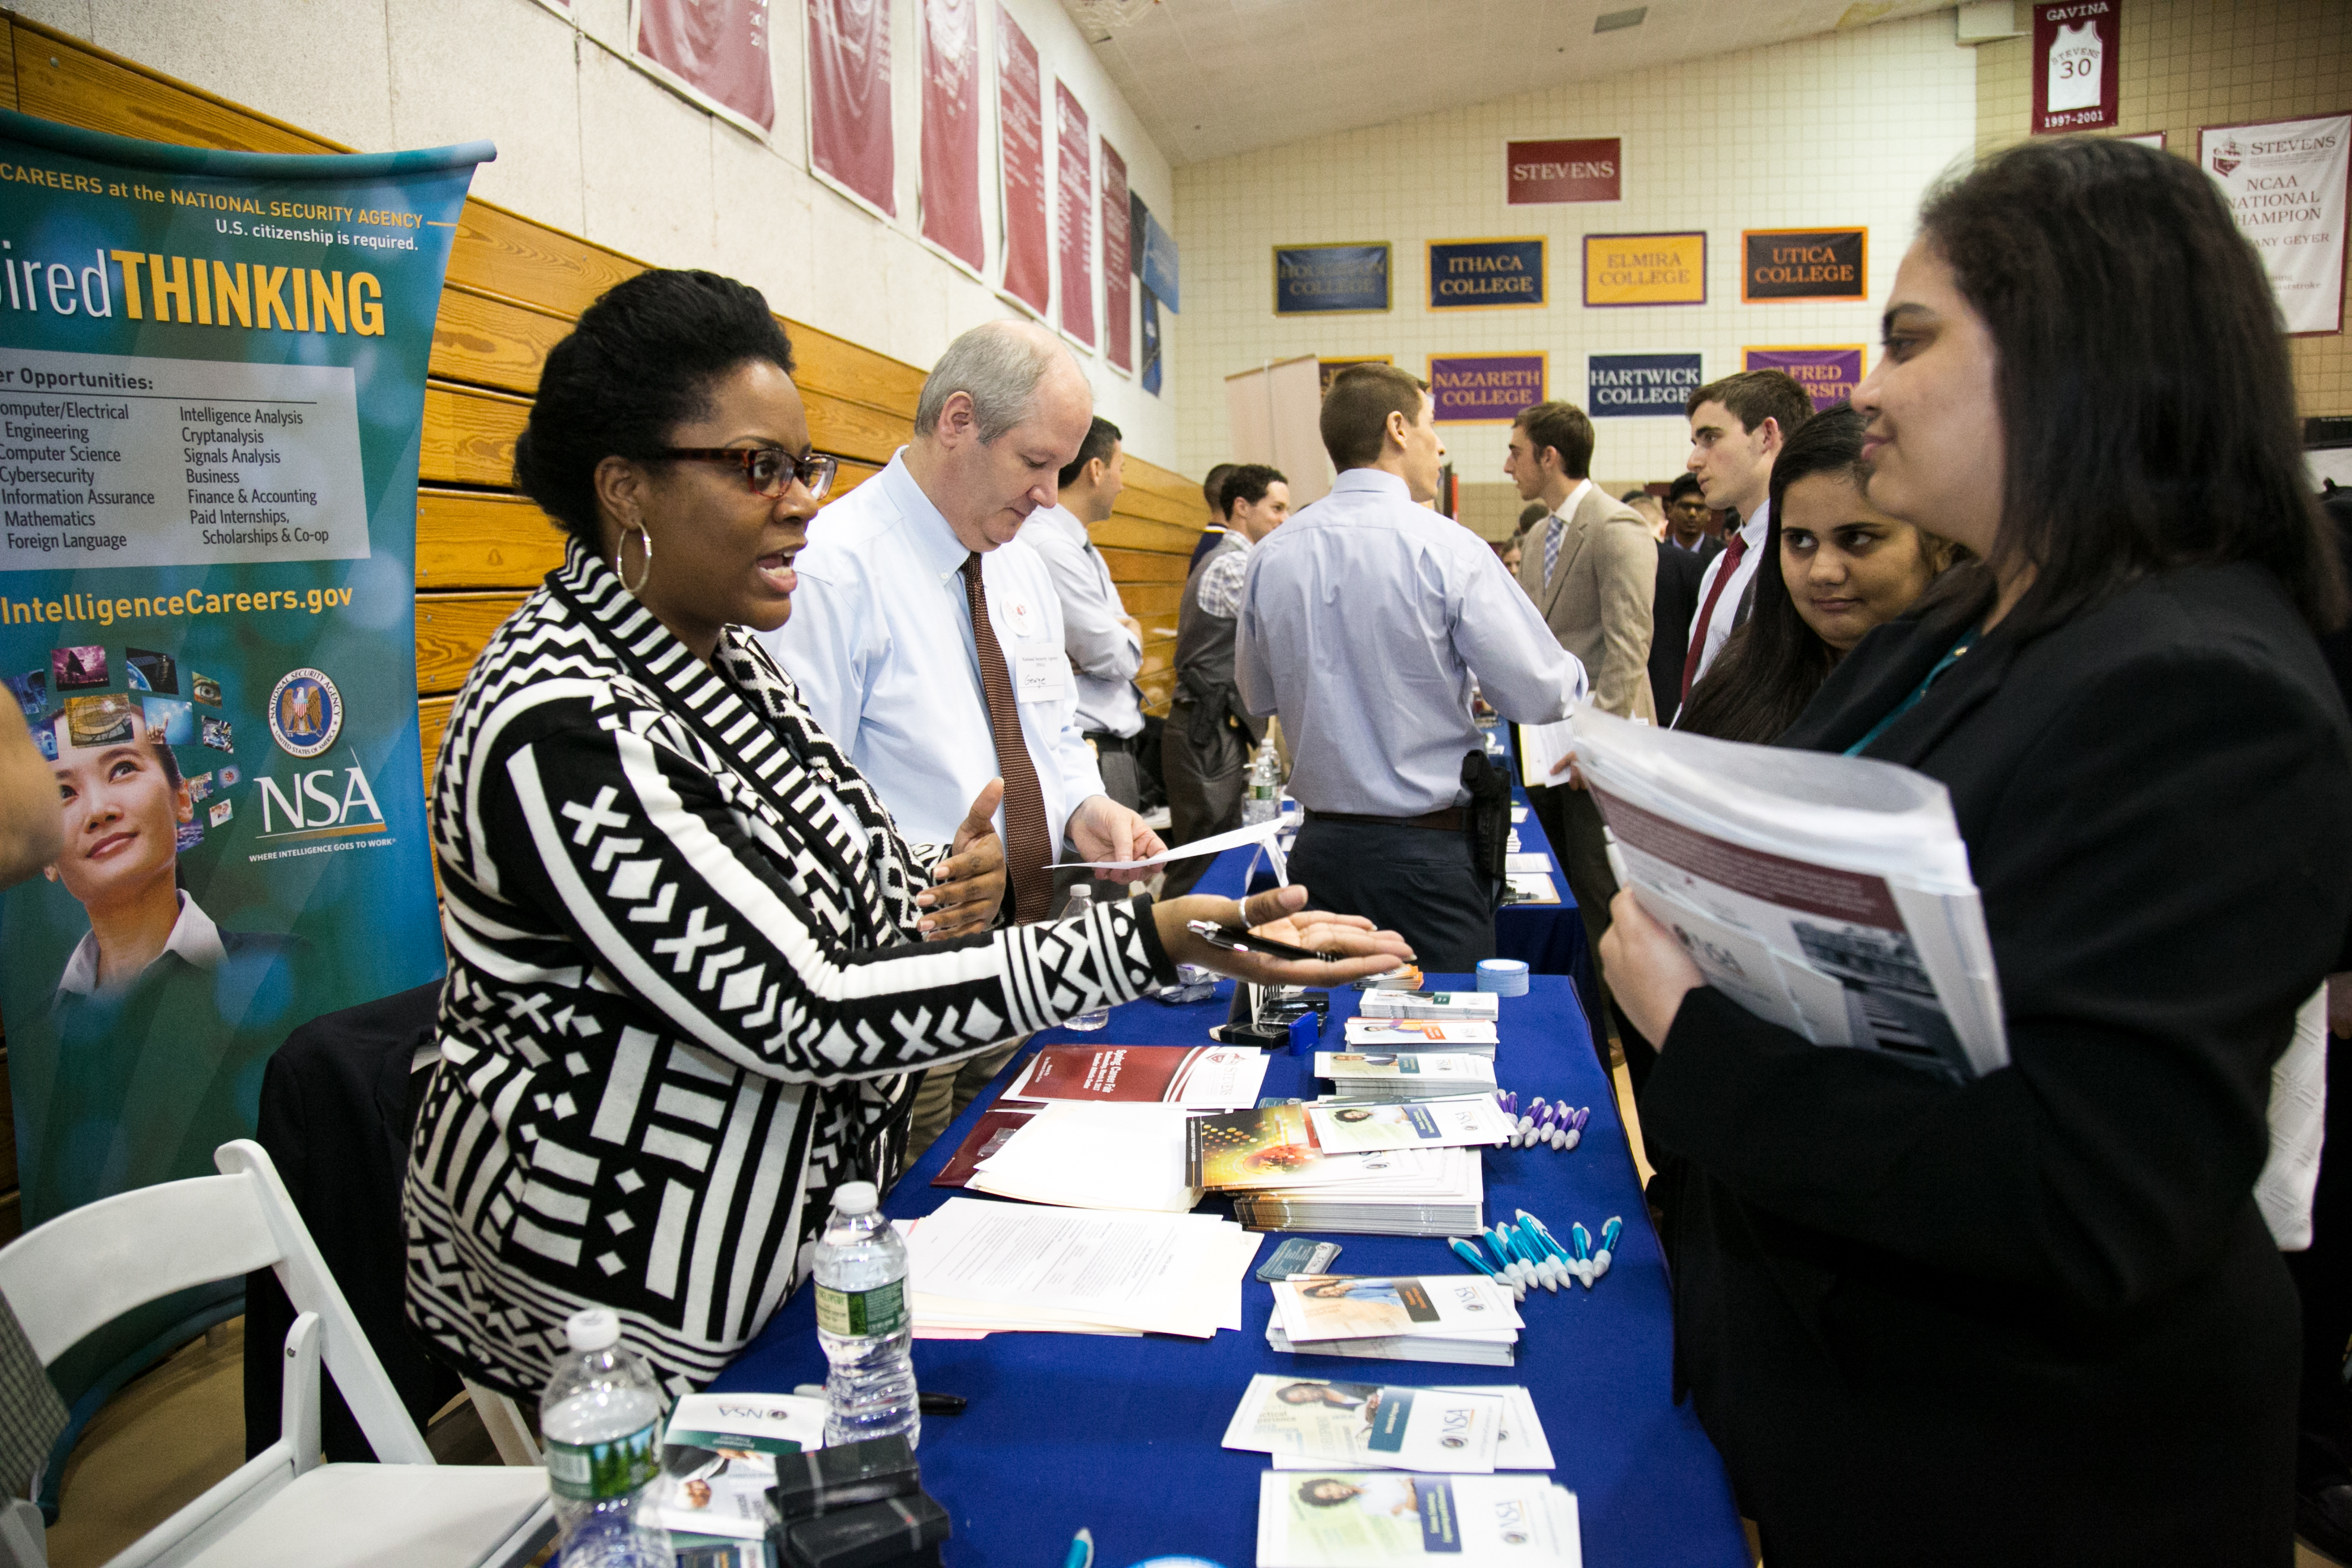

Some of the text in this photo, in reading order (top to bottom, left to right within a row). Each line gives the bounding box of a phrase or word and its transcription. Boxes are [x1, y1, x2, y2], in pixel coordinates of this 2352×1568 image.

[2047, 2, 2109, 22] GAVINA
[2050, 47, 2101, 65] STEVENS
[2059, 58, 2091, 80] 30
[2044, 110, 2104, 128] 1997-2001
[2250, 136, 2336, 156] STEVENS
[1513, 161, 1615, 182] STEVENS
[2246, 176, 2298, 192] NCAA
[0, 162, 423, 229] CAREERS at the NATIONAL SECURITY AGENCY
[2235, 208, 2321, 226] HAMPION
[216, 219, 418, 251] U.S. citizenship is required.
[2283, 233, 2329, 246] GEYER
[1607, 251, 1682, 269] ELMIRA
[1772, 246, 1836, 264] UTICA
[1449, 255, 1523, 275] ITHACA
[1754, 264, 1854, 284] COLLEGE
[1440, 276, 1534, 295] COLLEGE
[1598, 268, 1690, 287] COLLEGE
[21, 368, 153, 390] Opportunities:
[1435, 369, 1540, 388] NAZARETH
[1590, 368, 1699, 386] HARTWICK
[1788, 364, 1842, 381] FRED
[1441, 389, 1532, 407] COLLEGE
[1597, 387, 1690, 404] COLLEGE
[180, 406, 303, 426] Intelligence Analysis
[5, 422, 90, 444] Engineering
[182, 427, 264, 445] Cryptanalysis
[0, 444, 121, 463] Computer Science
[184, 448, 280, 466] Signals Analysis
[0, 466, 94, 486] Cybersecurity
[186, 469, 239, 484] Business
[2, 489, 154, 504] Information Assurance
[188, 489, 317, 505] Finance & Accounting
[5, 511, 96, 526] Mathematics
[190, 509, 289, 524] Paid Internships,
[8, 533, 127, 552] Foreign Language
[203, 527, 328, 546] Scholarships & Co-op
[2, 587, 353, 625] IntelligenceCareers.gov
[1025, 675, 1046, 688] George
[270, 669, 341, 719] NATIONAL SECURITY AGENCY
[274, 730, 291, 750] UNITED
[292, 747, 311, 755] STATES
[318, 729, 336, 750] AMERICA
[253, 766, 385, 832] NSA
[249, 851, 277, 862] WHERE
[279, 845, 333, 858] INTELLIGENCE
[334, 842, 355, 851] GOES
[1102, 1049, 1127, 1093] Spring Career Fair
[1220, 1067, 1238, 1096] STEVENS
[1455, 1286, 1478, 1306] NSA
[718, 1406, 764, 1420] NSA
[1442, 1408, 1470, 1435] NSA
[1496, 1501, 1522, 1529] NSA
